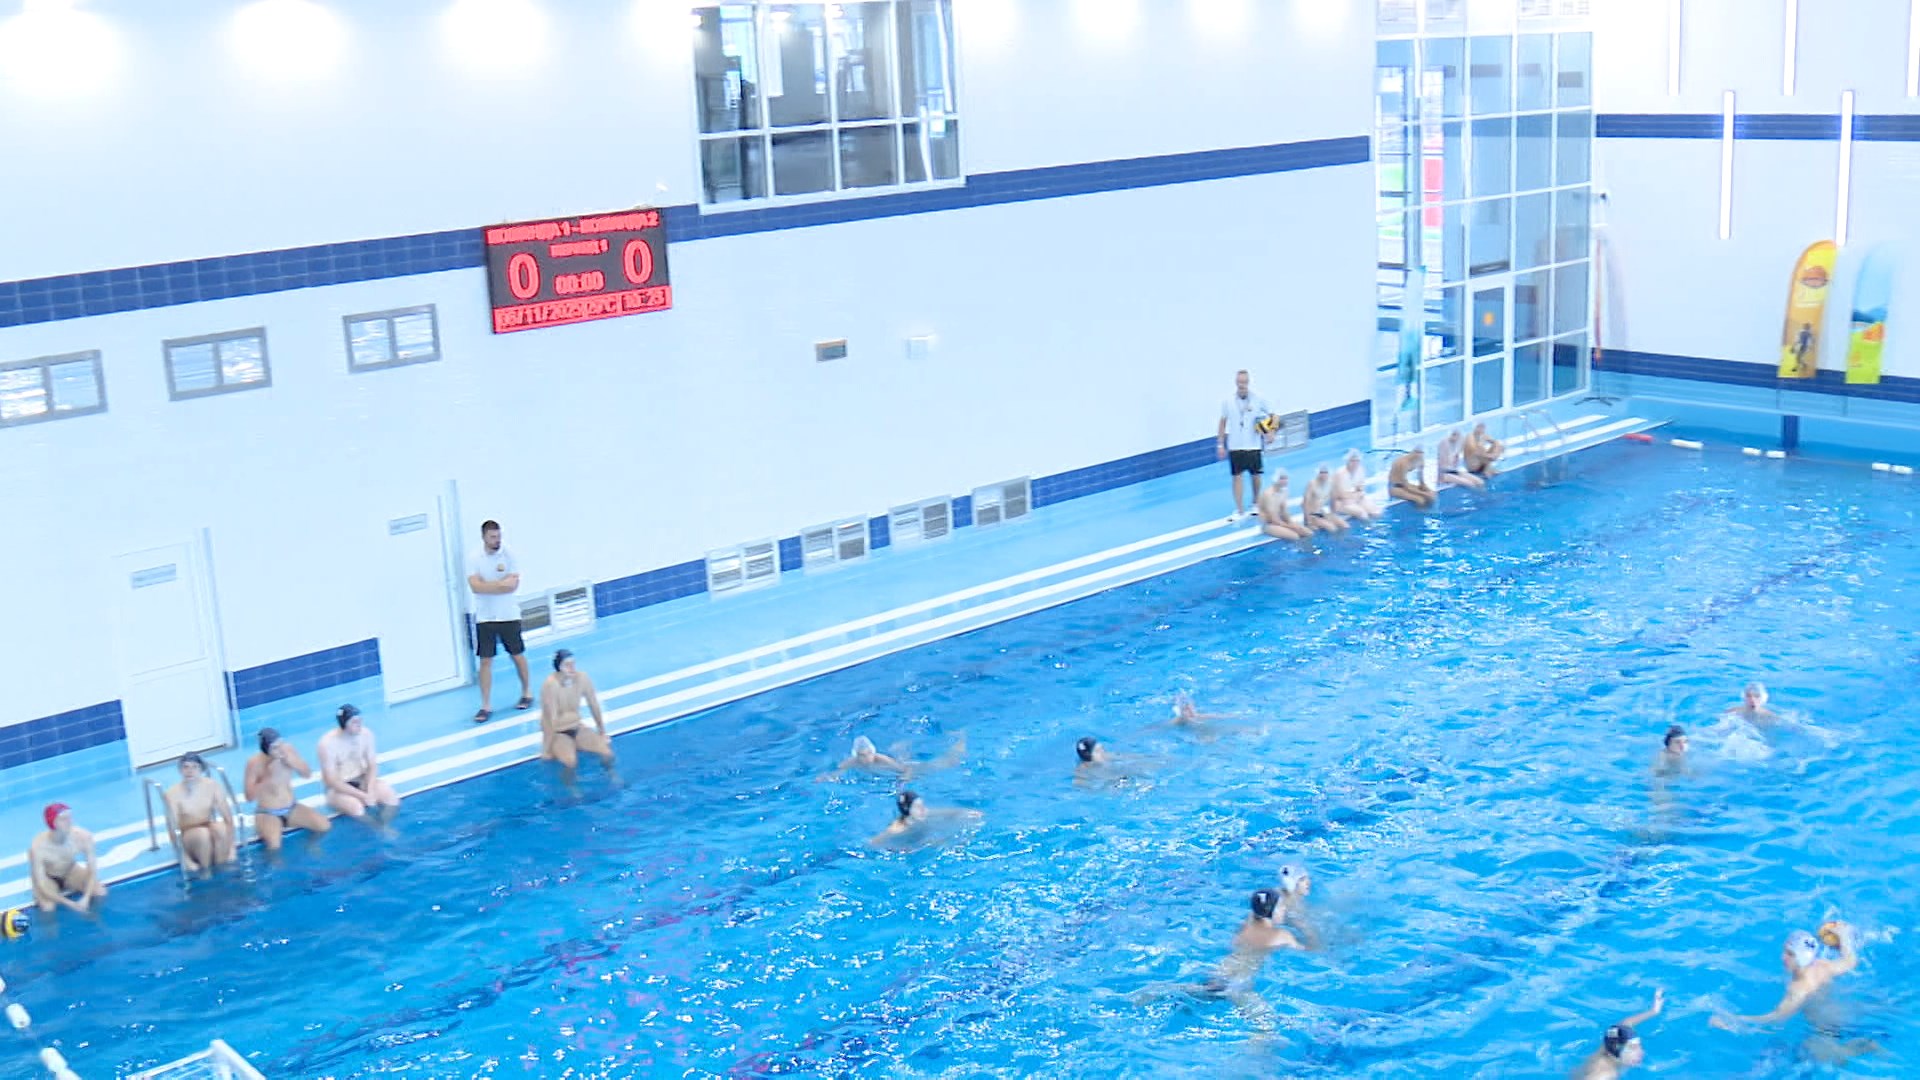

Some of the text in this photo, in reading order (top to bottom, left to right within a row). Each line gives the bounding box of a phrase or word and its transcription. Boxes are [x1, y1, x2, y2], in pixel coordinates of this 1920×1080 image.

[508, 252, 540, 299] 0
[554, 270, 605, 295] 00:00
[623, 239, 653, 284] 0
